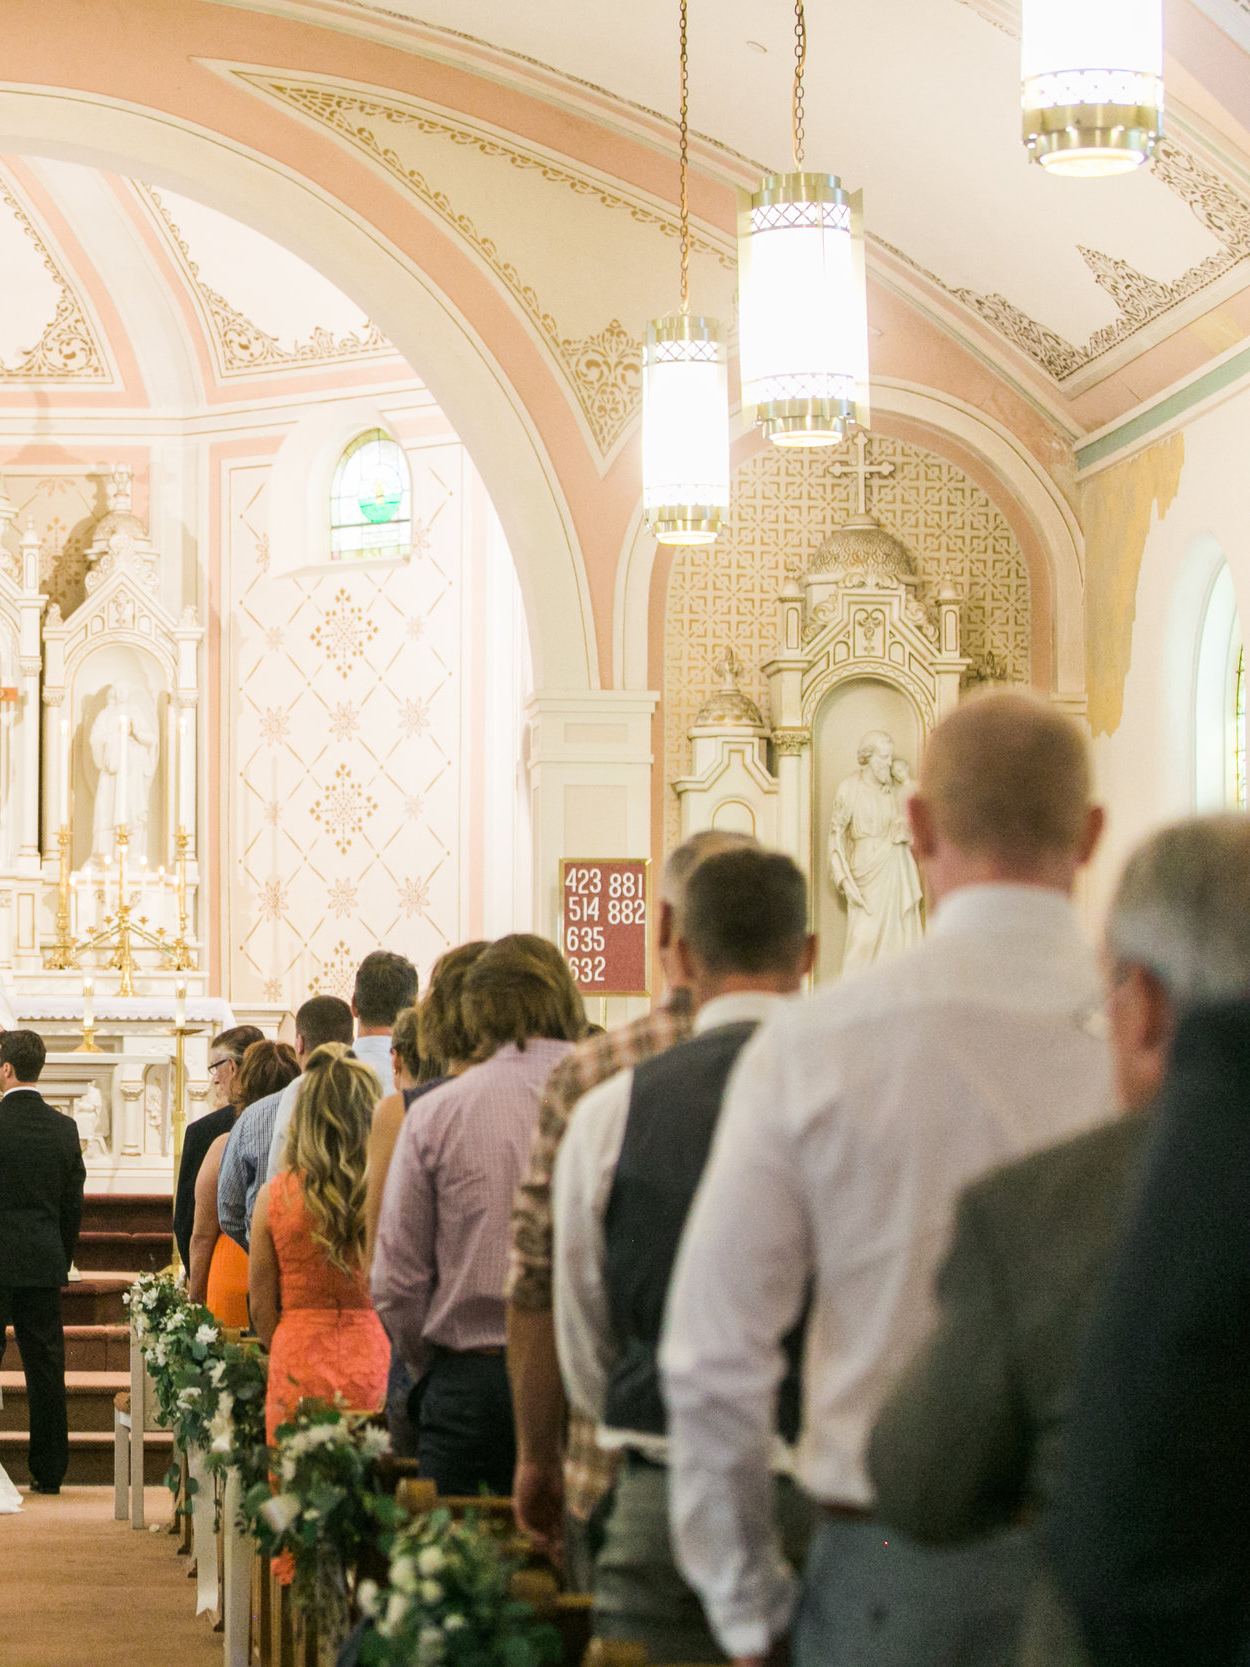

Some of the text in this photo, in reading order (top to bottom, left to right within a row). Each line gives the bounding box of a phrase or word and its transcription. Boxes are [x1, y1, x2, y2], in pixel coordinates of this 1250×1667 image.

[565, 868, 642, 898] 423 881
[569, 896, 645, 924] 514 882
[567, 926, 604, 952] 635
[568, 956, 605, 982] 632
